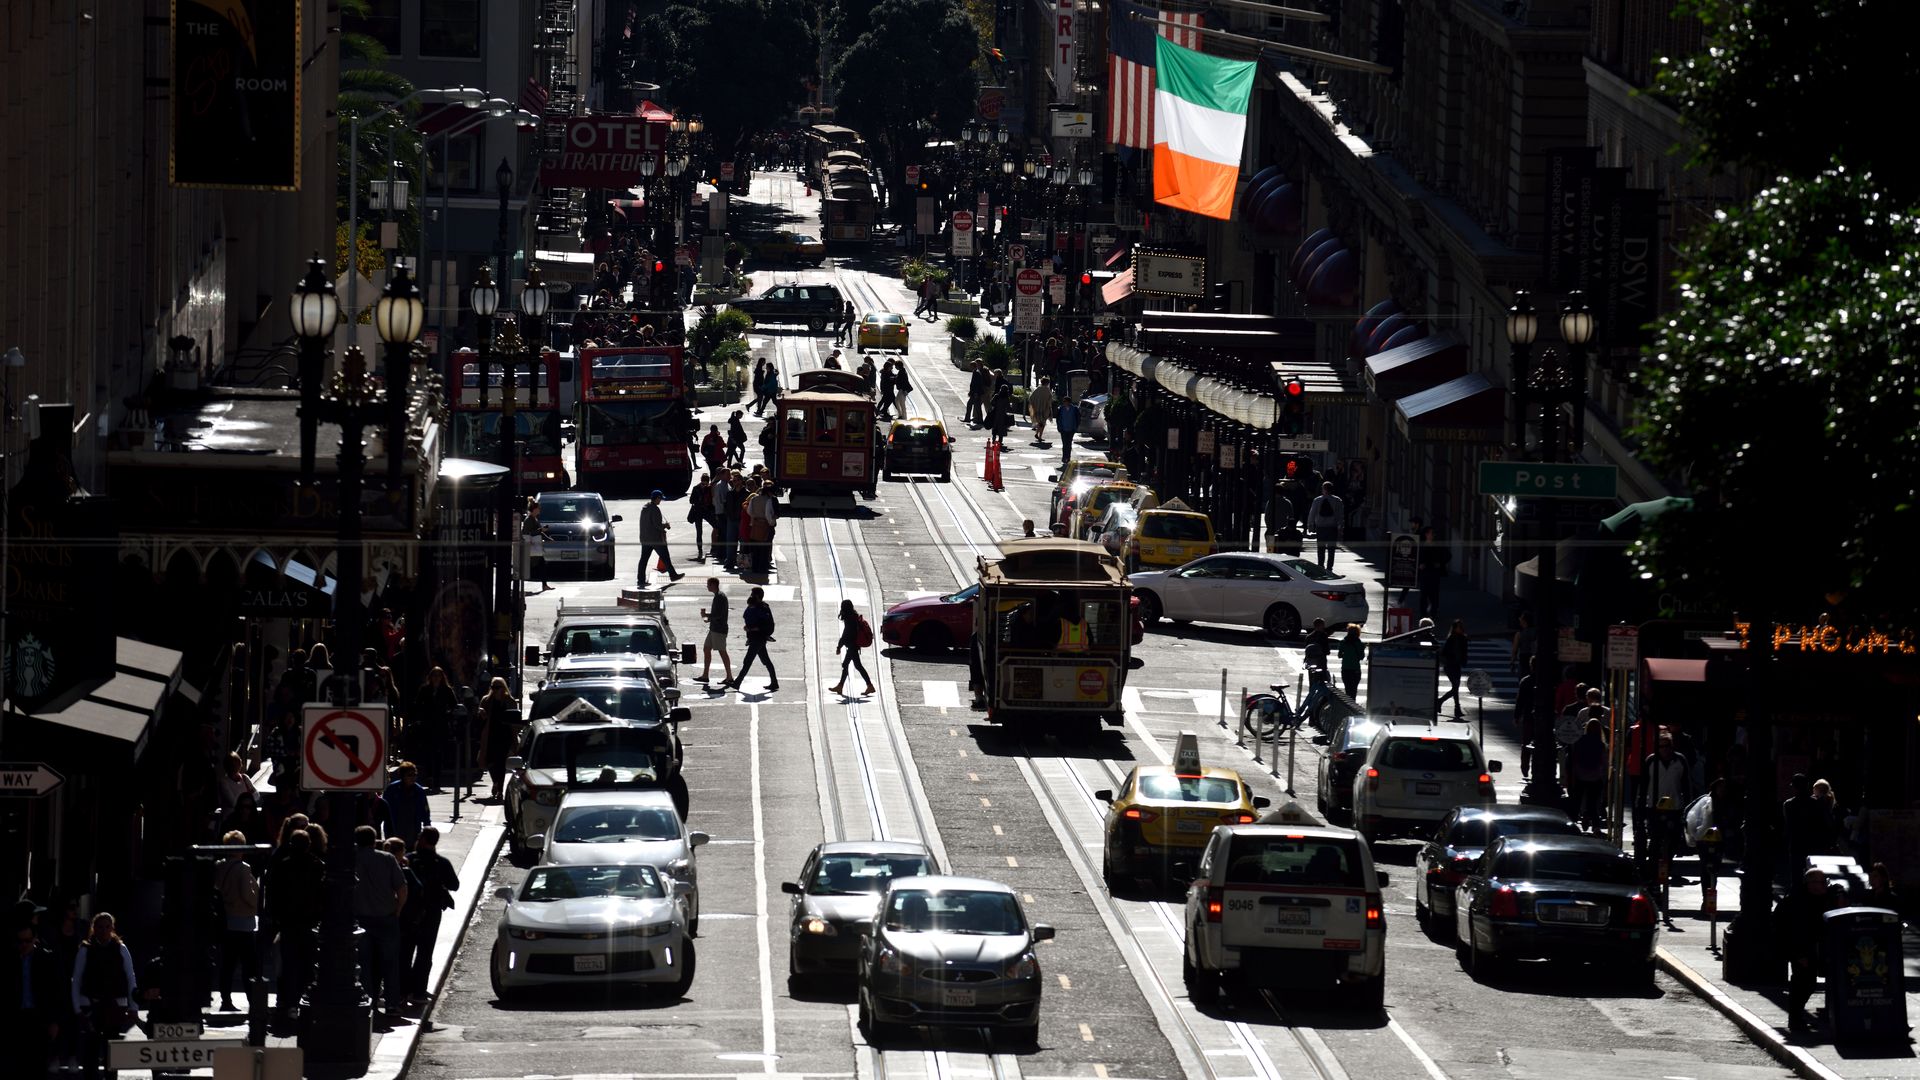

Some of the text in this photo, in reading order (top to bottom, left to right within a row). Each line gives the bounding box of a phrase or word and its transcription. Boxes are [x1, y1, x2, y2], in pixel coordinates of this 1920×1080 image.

[185, 21, 220, 36] THE
[235, 77, 287, 92] ROOM
[570, 122, 660, 150] OTEL
[1158, 270, 1183, 279] EXPRESS
[1621, 237, 1648, 309] DSW
[1292, 441, 1316, 449] Post
[1515, 470, 1582, 489] Post
[438, 507, 489, 526] HIPOTLE
[7, 543, 72, 567] RANCIS
[2, 773, 33, 787] WAY
[1228, 899, 1254, 911] 9046
[157, 1026, 184, 1038] 500
[139, 1046, 214, 1064] Sutter
